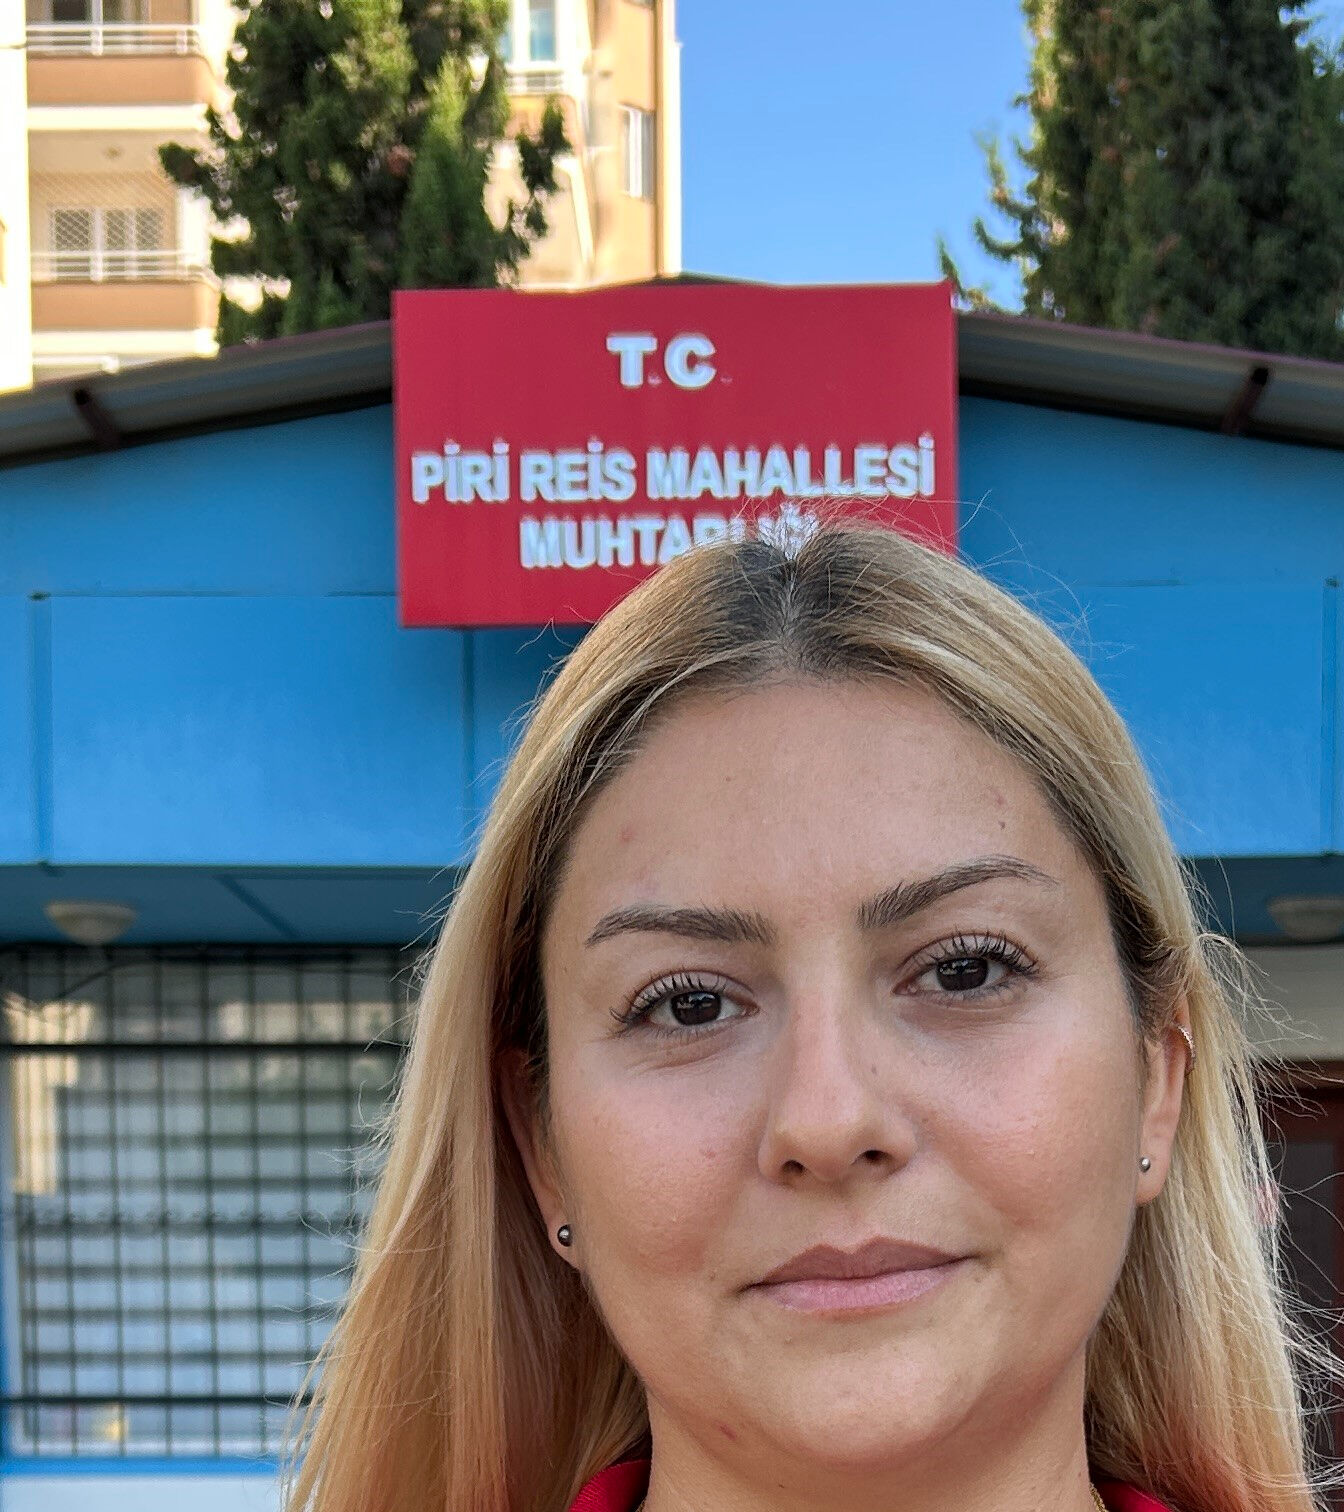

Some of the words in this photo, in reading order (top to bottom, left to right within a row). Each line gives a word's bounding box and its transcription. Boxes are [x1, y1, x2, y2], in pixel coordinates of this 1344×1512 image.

[411, 438, 510, 503] PİRİ
[520, 436, 637, 503] REİS
[646, 431, 936, 498] MAHALLESİ
[519, 495, 821, 569] MUHTAR
